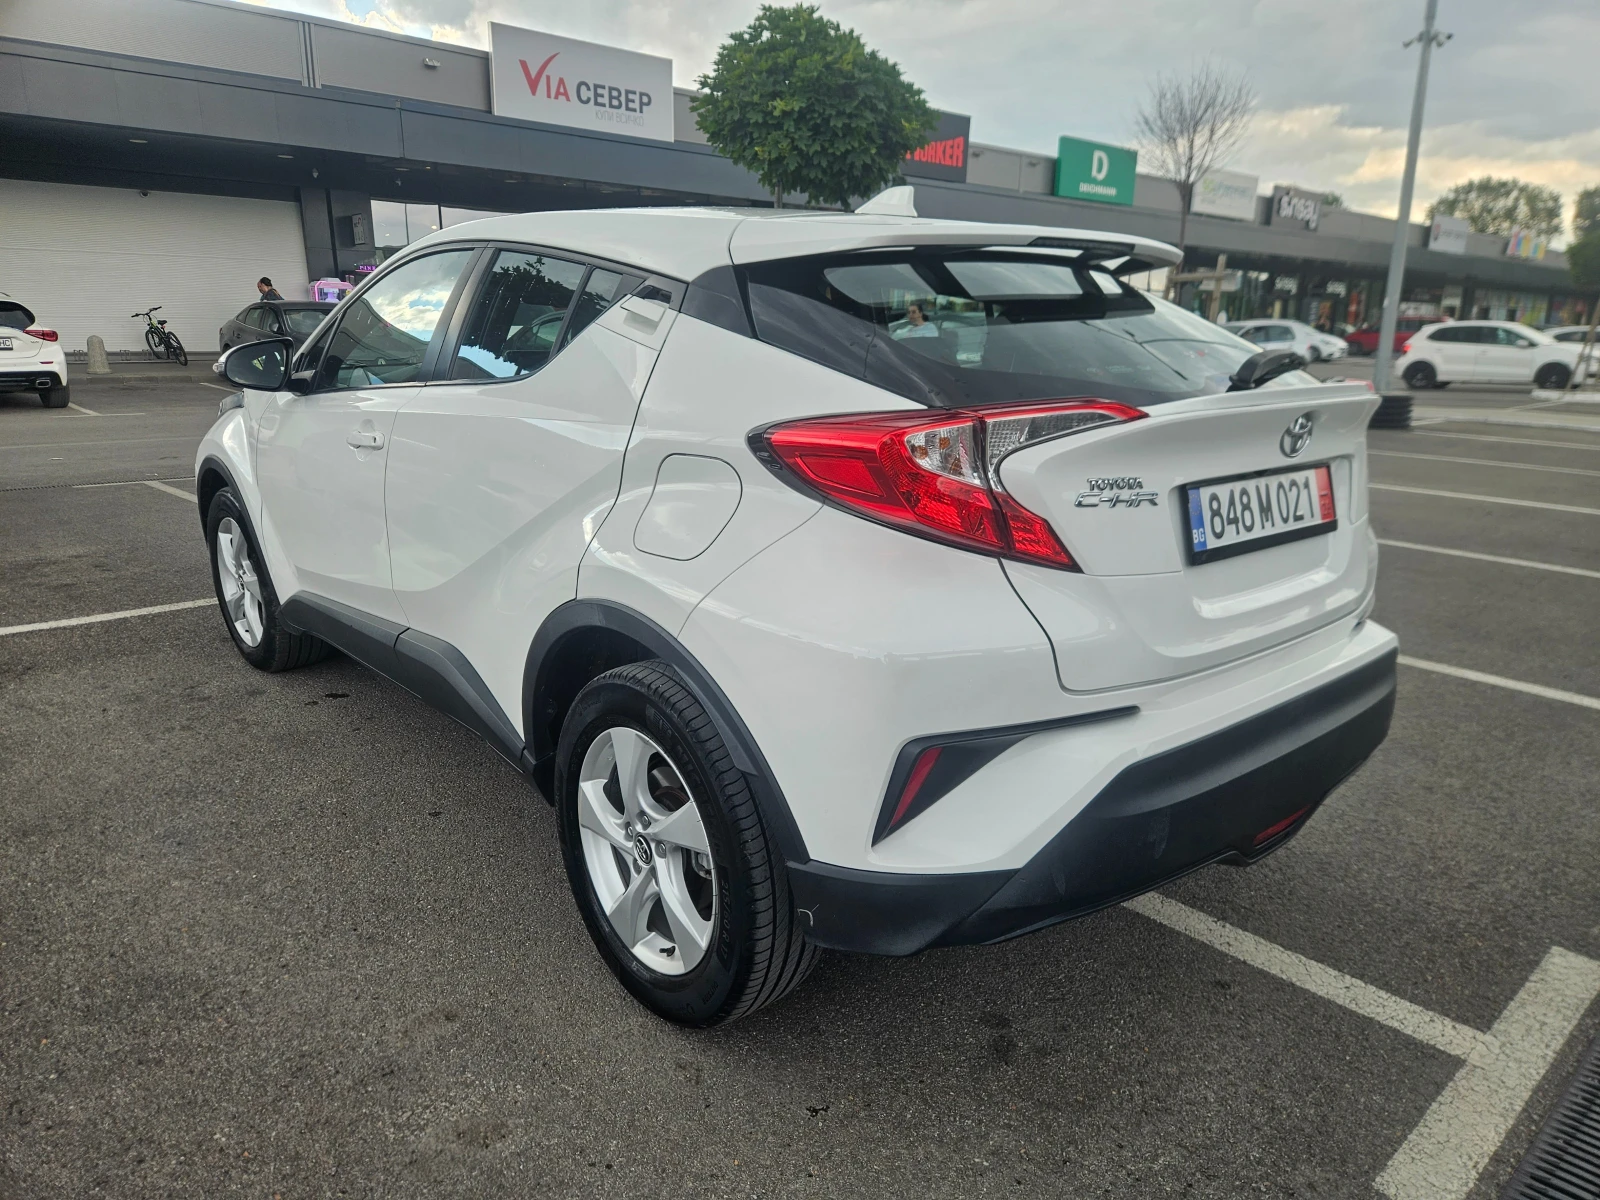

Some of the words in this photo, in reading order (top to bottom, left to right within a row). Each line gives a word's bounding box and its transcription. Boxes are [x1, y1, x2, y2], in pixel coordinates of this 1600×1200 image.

[518, 52, 571, 102] VIA
[575, 81, 652, 114] СЕВЕР
[595, 109, 614, 124] КУПИ
[615, 112, 644, 127] ВСИЧКО
[1091, 149, 1109, 182] D
[1087, 477, 1144, 491] TOYOTA
[1074, 491, 1159, 508] C-HR
[1208, 486, 1255, 540] 848
[1255, 481, 1275, 530] M
[1276, 475, 1315, 525] 021
[1192, 529, 1205, 544] BG
